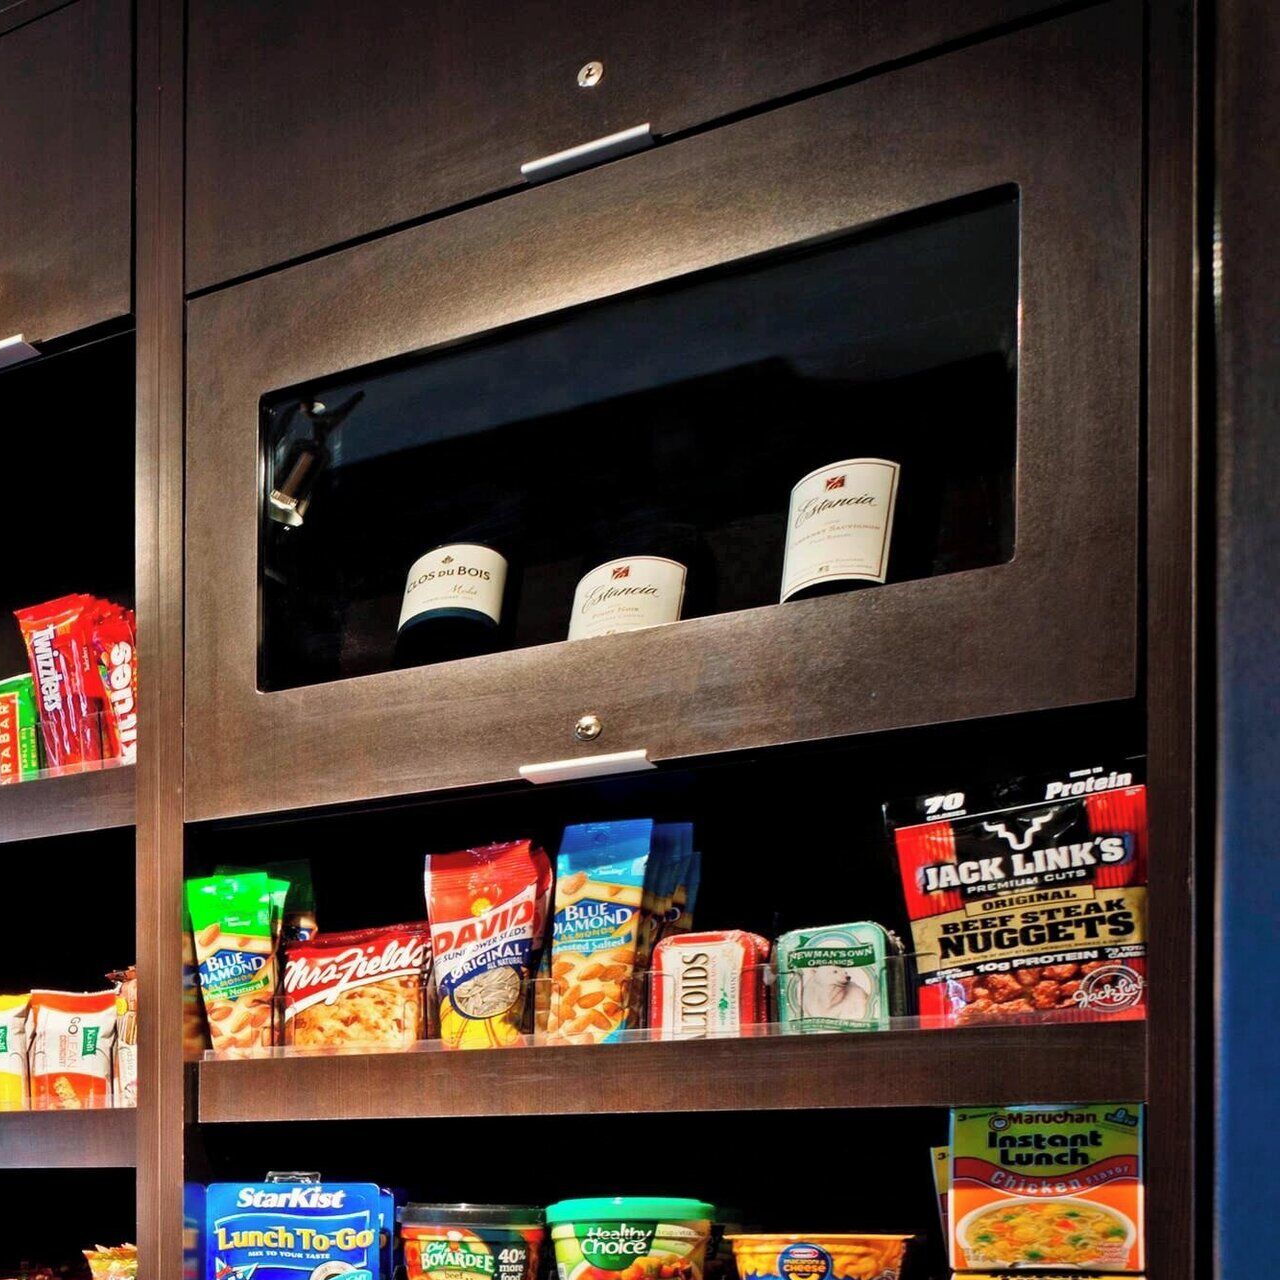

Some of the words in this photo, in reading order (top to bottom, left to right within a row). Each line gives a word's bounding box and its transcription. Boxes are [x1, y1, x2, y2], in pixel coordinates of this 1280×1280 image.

[457, 566, 491, 581] BOIS
[1045, 771, 1133, 801] Protein
[924, 792, 966, 815] 70
[925, 857, 1005, 892] JACK
[1012, 837, 1126, 877] LINK'S
[966, 877, 1039, 895] PREMIUM
[1044, 869, 1087, 882] CUTS
[981, 889, 1077, 912] ORIGINAL
[565, 903, 609, 922] BLUE
[941, 915, 1014, 935] BEEF
[1021, 898, 1126, 925] STEAK
[434, 900, 534, 953] DAVID
[937, 911, 1135, 960] NUGGETS
[206, 952, 245, 972] BLUE
[1013, 951, 1098, 968] PROTEIN
[1006, 1111, 1097, 1125] Maruchan
[987, 1129, 1103, 1150] Instant
[999, 1148, 1090, 1167] Lunch
[990, 1170, 1083, 1194] Chicken
[236, 1185, 347, 1208] StarKist
[216, 1226, 295, 1251] Lunch
[296, 1226, 376, 1252] To-Go
[587, 1223, 652, 1242] Healthy
[497, 1248, 527, 1263] 40%
[580, 1235, 648, 1256] Choice
[420, 1250, 495, 1274] BOYARDEE
[498, 1263, 524, 1273] more
[444, 1270, 464, 1280] beef
